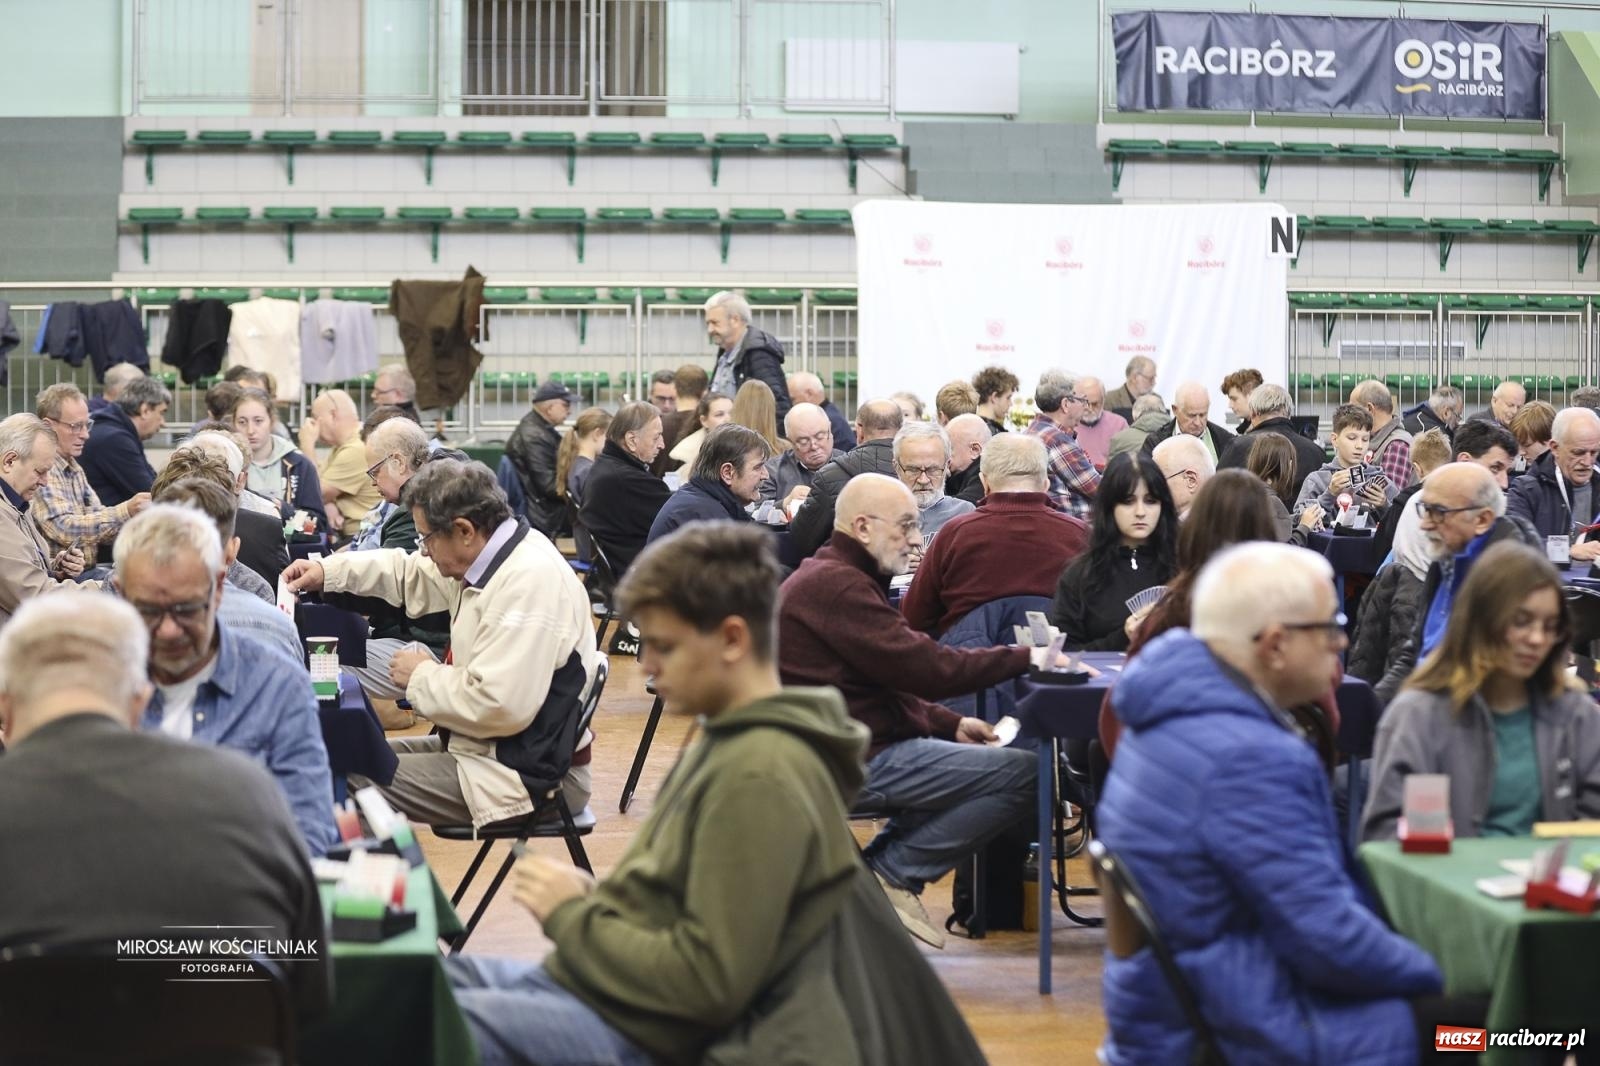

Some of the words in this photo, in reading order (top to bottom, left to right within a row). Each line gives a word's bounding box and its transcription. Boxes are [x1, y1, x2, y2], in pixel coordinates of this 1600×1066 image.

[1155, 39, 1336, 78] RACIBÓRZ
[1394, 39, 1504, 82] OSiR
[1438, 82, 1504, 97] RACIBÓRZ
[1271, 217, 1293, 253] N
